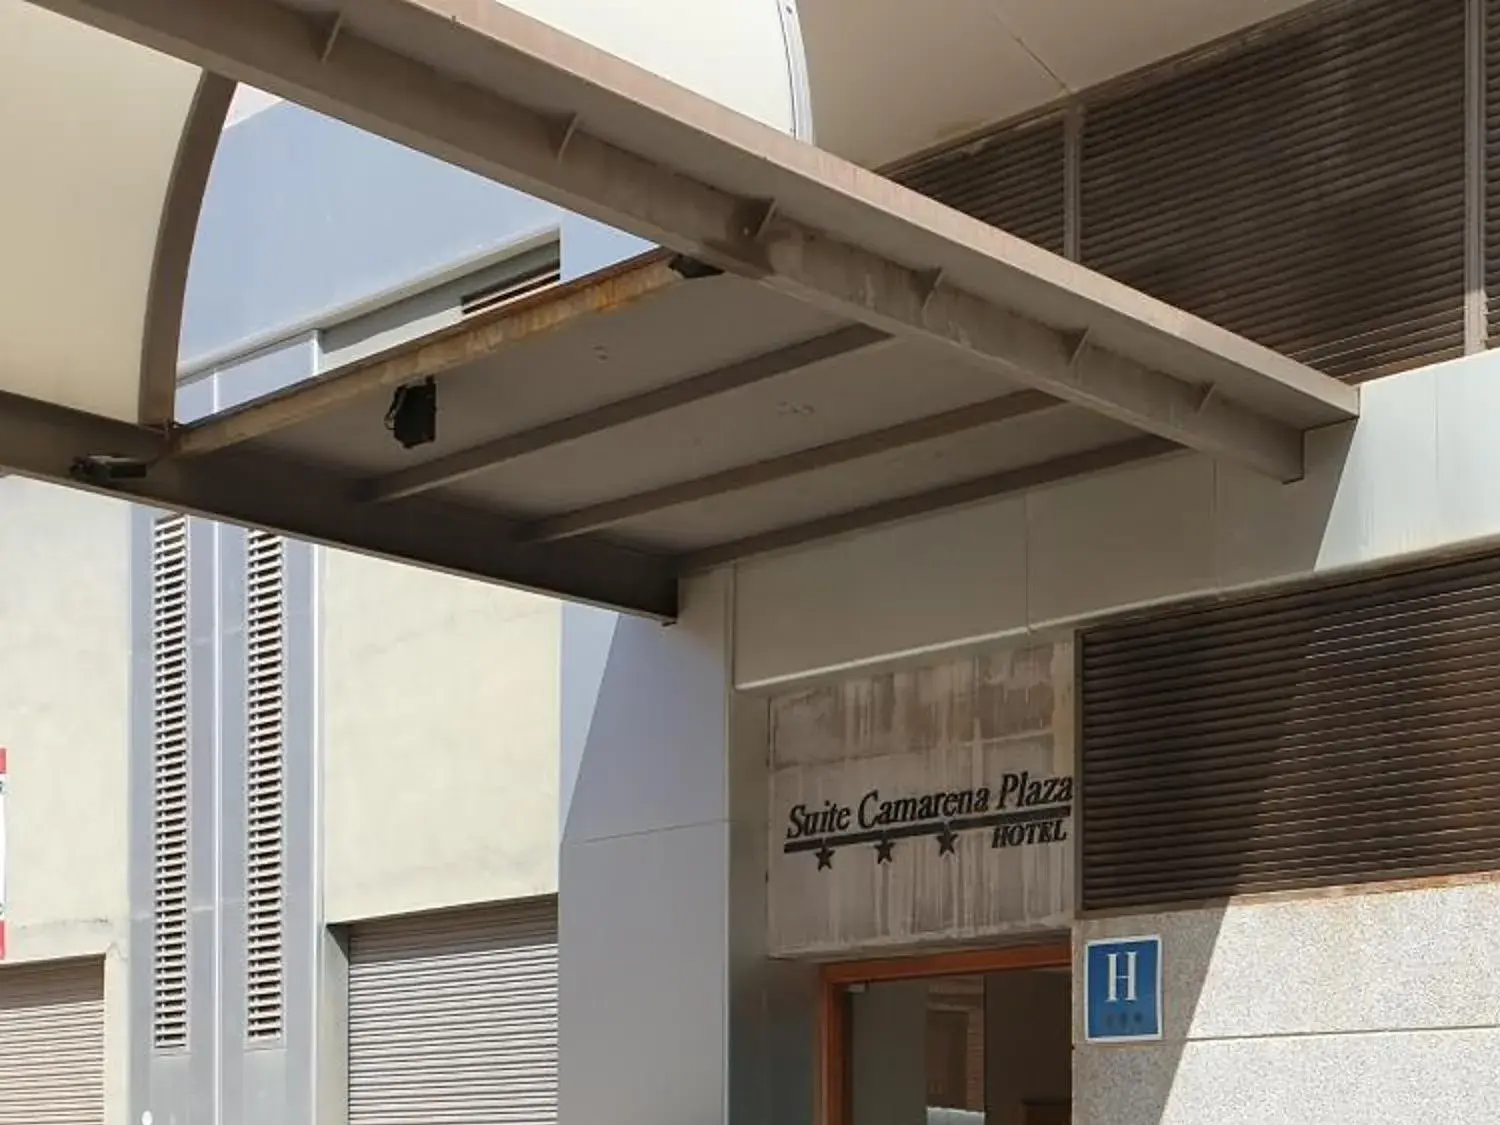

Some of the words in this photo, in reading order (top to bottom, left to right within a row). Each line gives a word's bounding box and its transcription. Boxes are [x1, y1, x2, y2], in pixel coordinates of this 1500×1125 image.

[786, 800, 850, 839] Suite
[858, 789, 990, 828] Camarena
[996, 771, 1073, 810] Plaza
[991, 818, 1066, 849] HOTEL
[1106, 951, 1138, 1002] H
